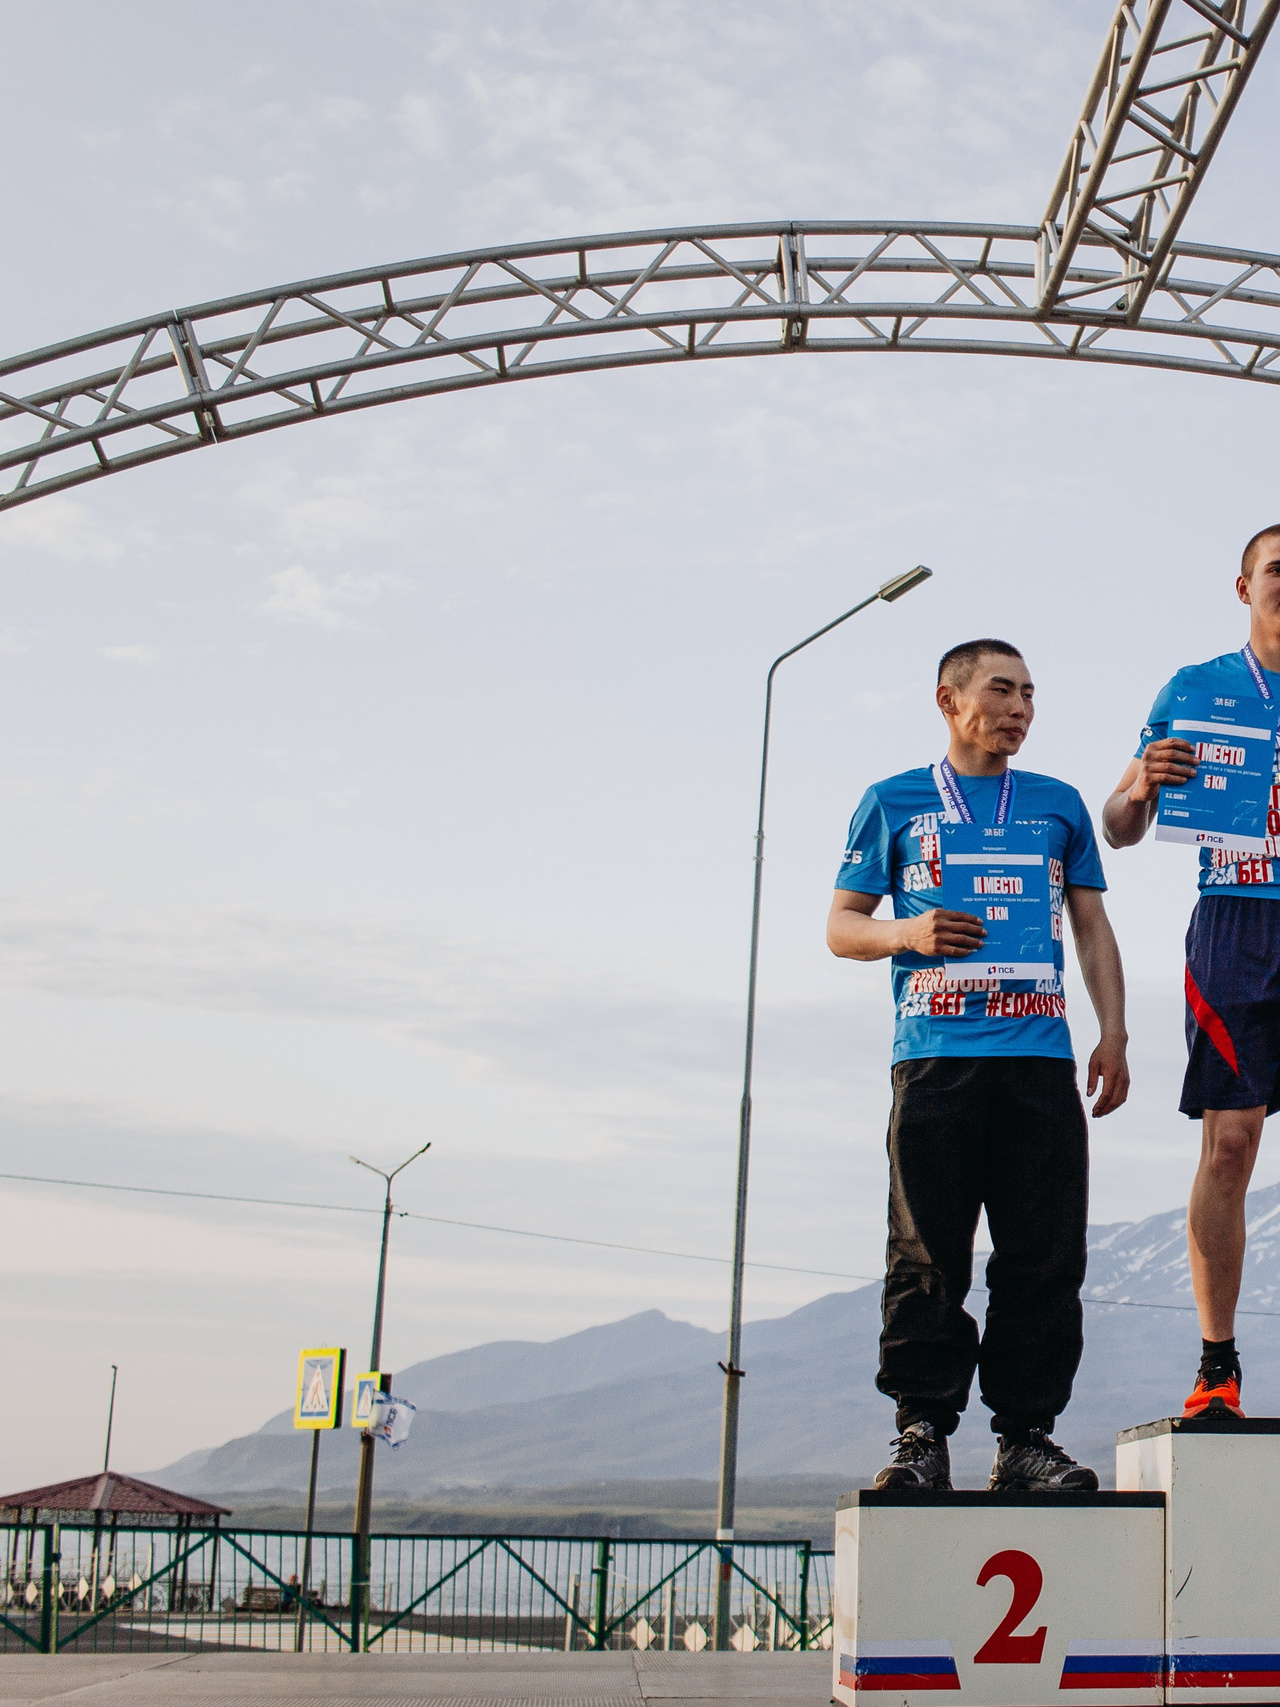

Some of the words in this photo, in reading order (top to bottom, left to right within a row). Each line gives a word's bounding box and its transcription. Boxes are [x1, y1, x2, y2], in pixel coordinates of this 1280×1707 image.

[1201, 743, 1246, 766] МЕСТО
[941, 763, 963, 804] САХАЛИНСКАЯ
[1204, 774, 1210, 789] 5
[1211, 775, 1227, 791] КМ
[1206, 859, 1274, 885] #ЗАБЕГ
[984, 877, 1023, 894] МЕСТО
[986, 906, 993, 920] 5
[994, 907, 1009, 920] КМ
[901, 993, 967, 1019] #ЗАБЕГ
[973, 1549, 1047, 1664] 2
